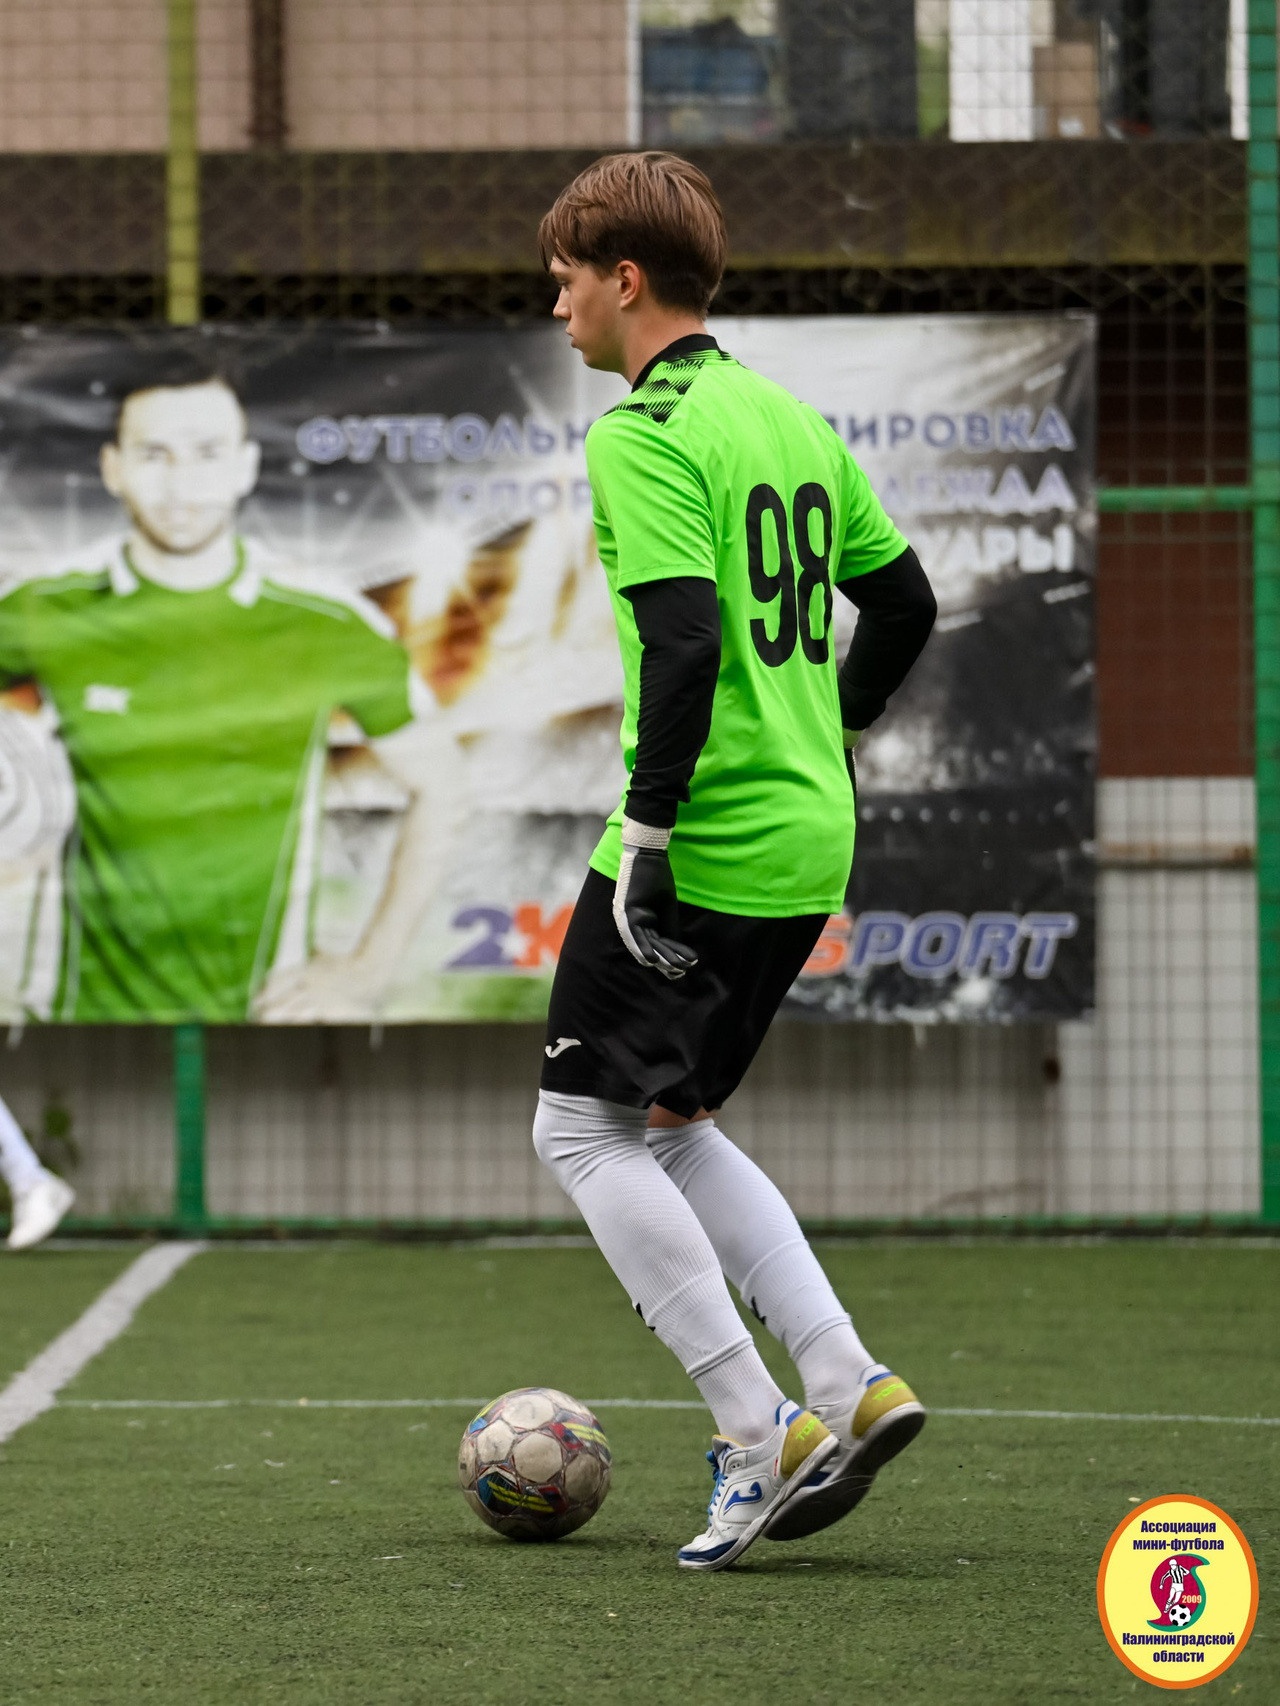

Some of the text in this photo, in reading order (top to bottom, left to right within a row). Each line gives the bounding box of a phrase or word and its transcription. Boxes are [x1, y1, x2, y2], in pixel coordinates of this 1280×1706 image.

[824, 405, 1078, 453] ИРОВКА
[746, 482, 832, 667] 98
[804, 911, 1076, 979] SPORT
